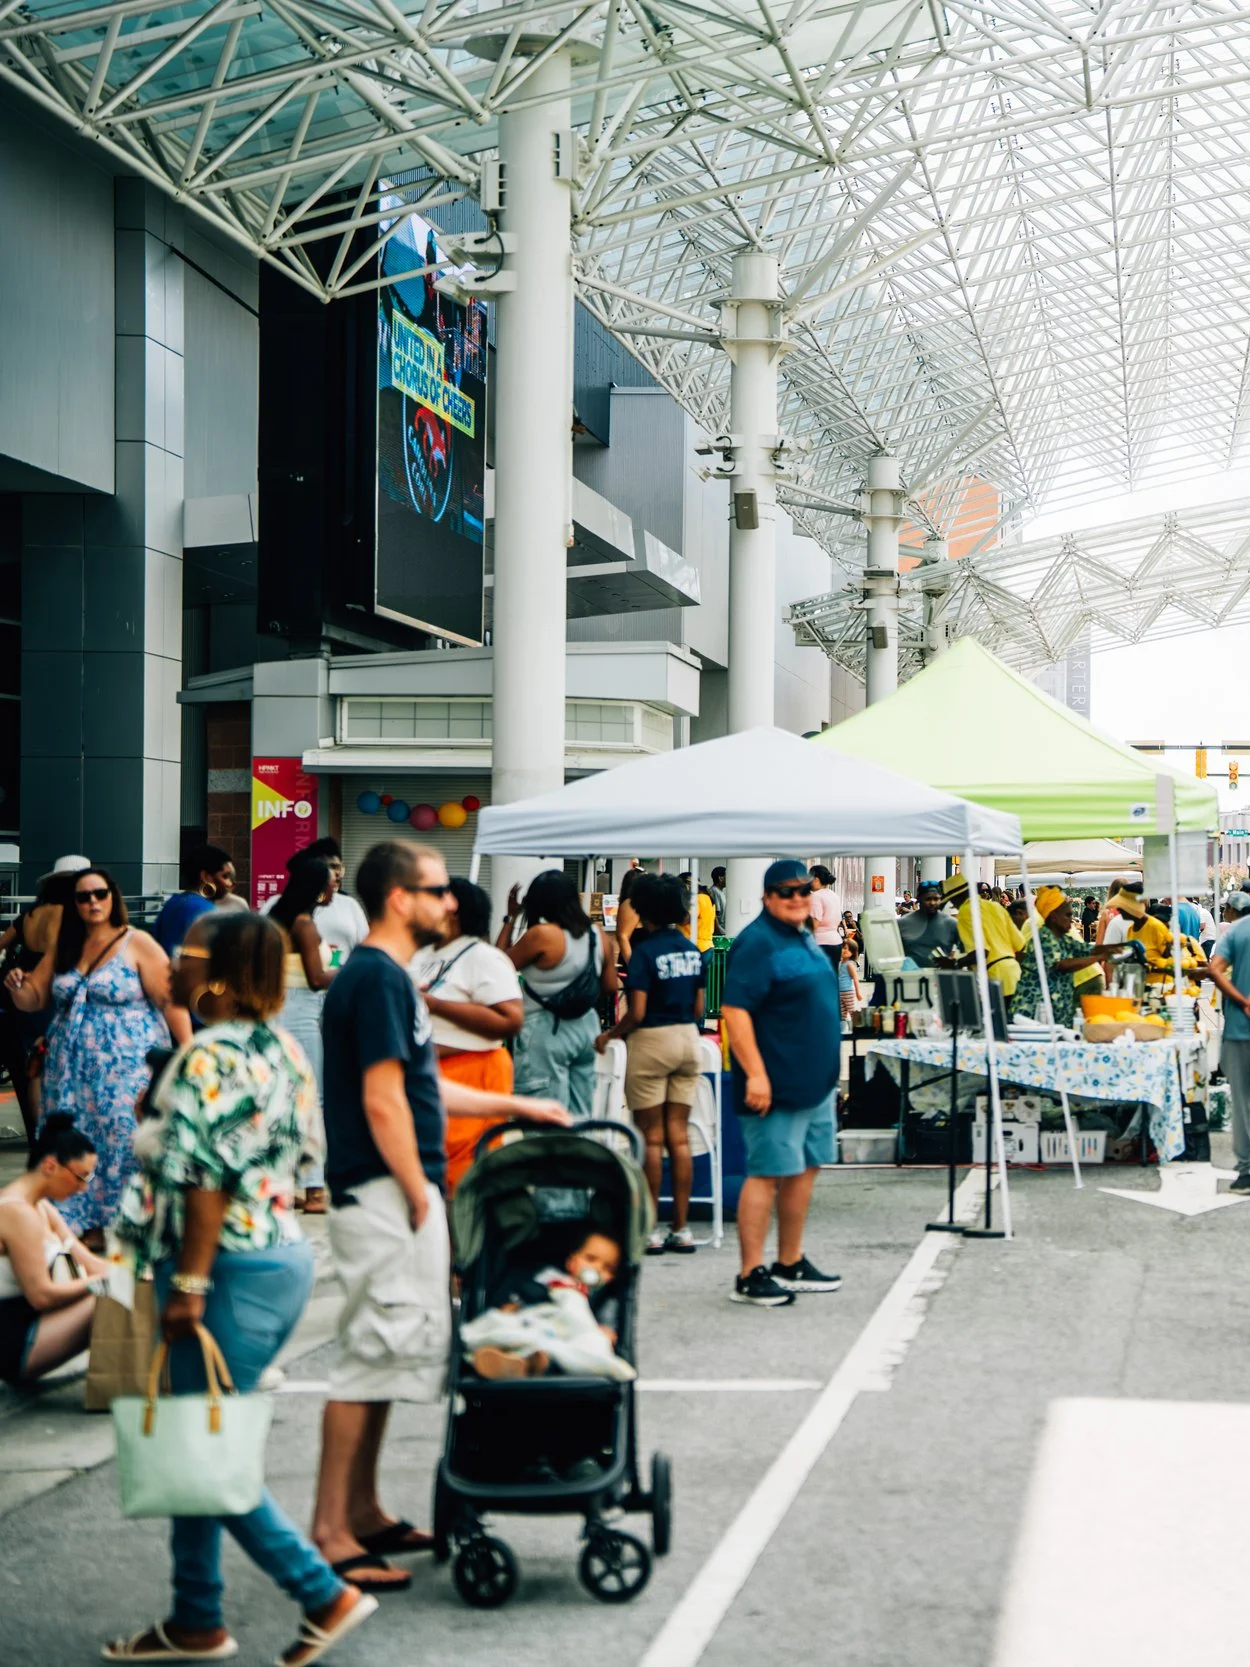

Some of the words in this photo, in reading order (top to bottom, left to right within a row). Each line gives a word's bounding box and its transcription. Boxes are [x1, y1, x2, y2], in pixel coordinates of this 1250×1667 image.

[393, 319, 425, 367] UNITED
[426, 343, 435, 375] IN
[436, 351, 443, 381] A
[393, 350, 429, 400] CHORUS
[429, 376, 441, 408] OF
[442, 385, 472, 429] CHEERS
[1070, 646, 1087, 713] ARTERI
[256, 800, 313, 819] INFO
[655, 950, 702, 980] STAFF
